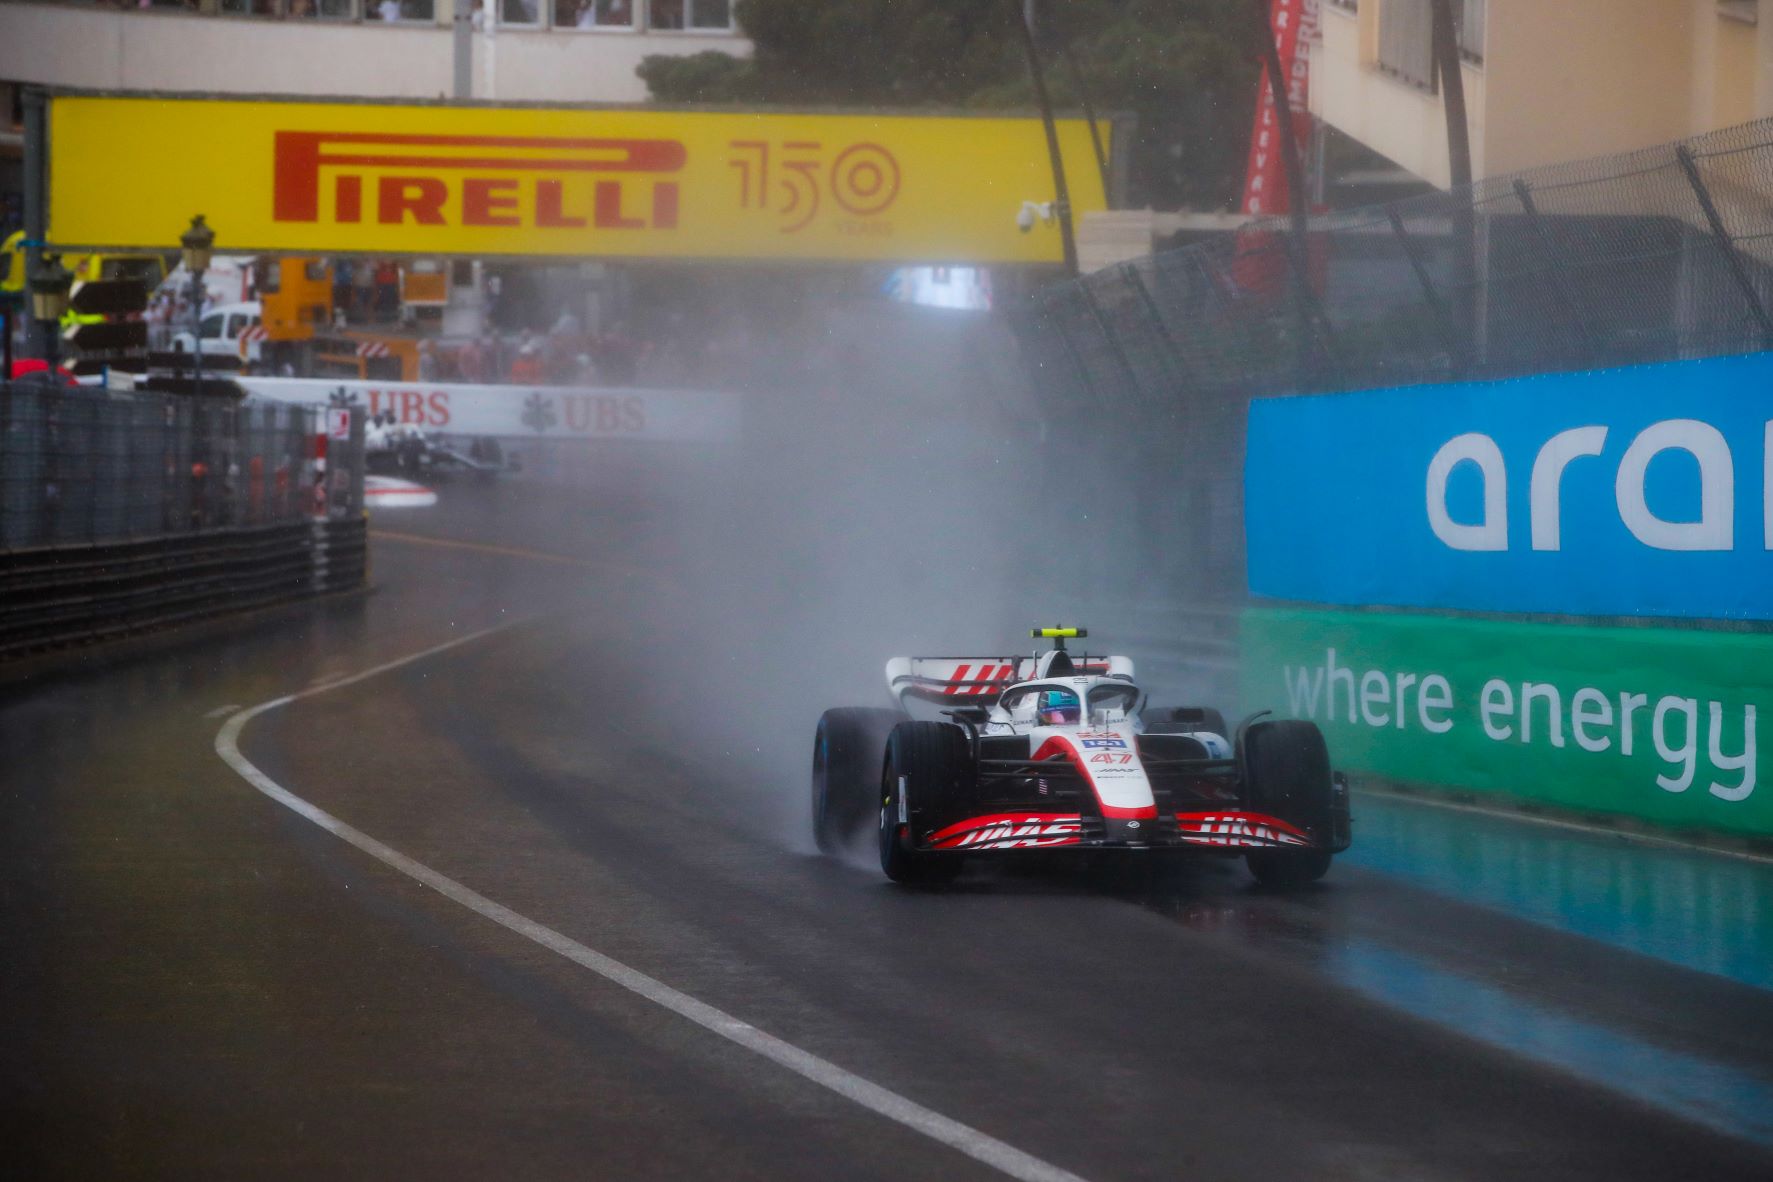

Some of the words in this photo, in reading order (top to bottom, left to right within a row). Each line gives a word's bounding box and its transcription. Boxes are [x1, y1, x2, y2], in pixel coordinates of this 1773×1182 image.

[273, 131, 687, 229] PIRELLI
[728, 140, 902, 234] 150
[368, 389, 450, 426] UBS
[563, 394, 646, 432] UBS
[1426, 418, 1773, 551] ara
[1090, 753, 1133, 764] 47
[1283, 647, 1455, 732] where
[1480, 677, 1757, 802] energy
